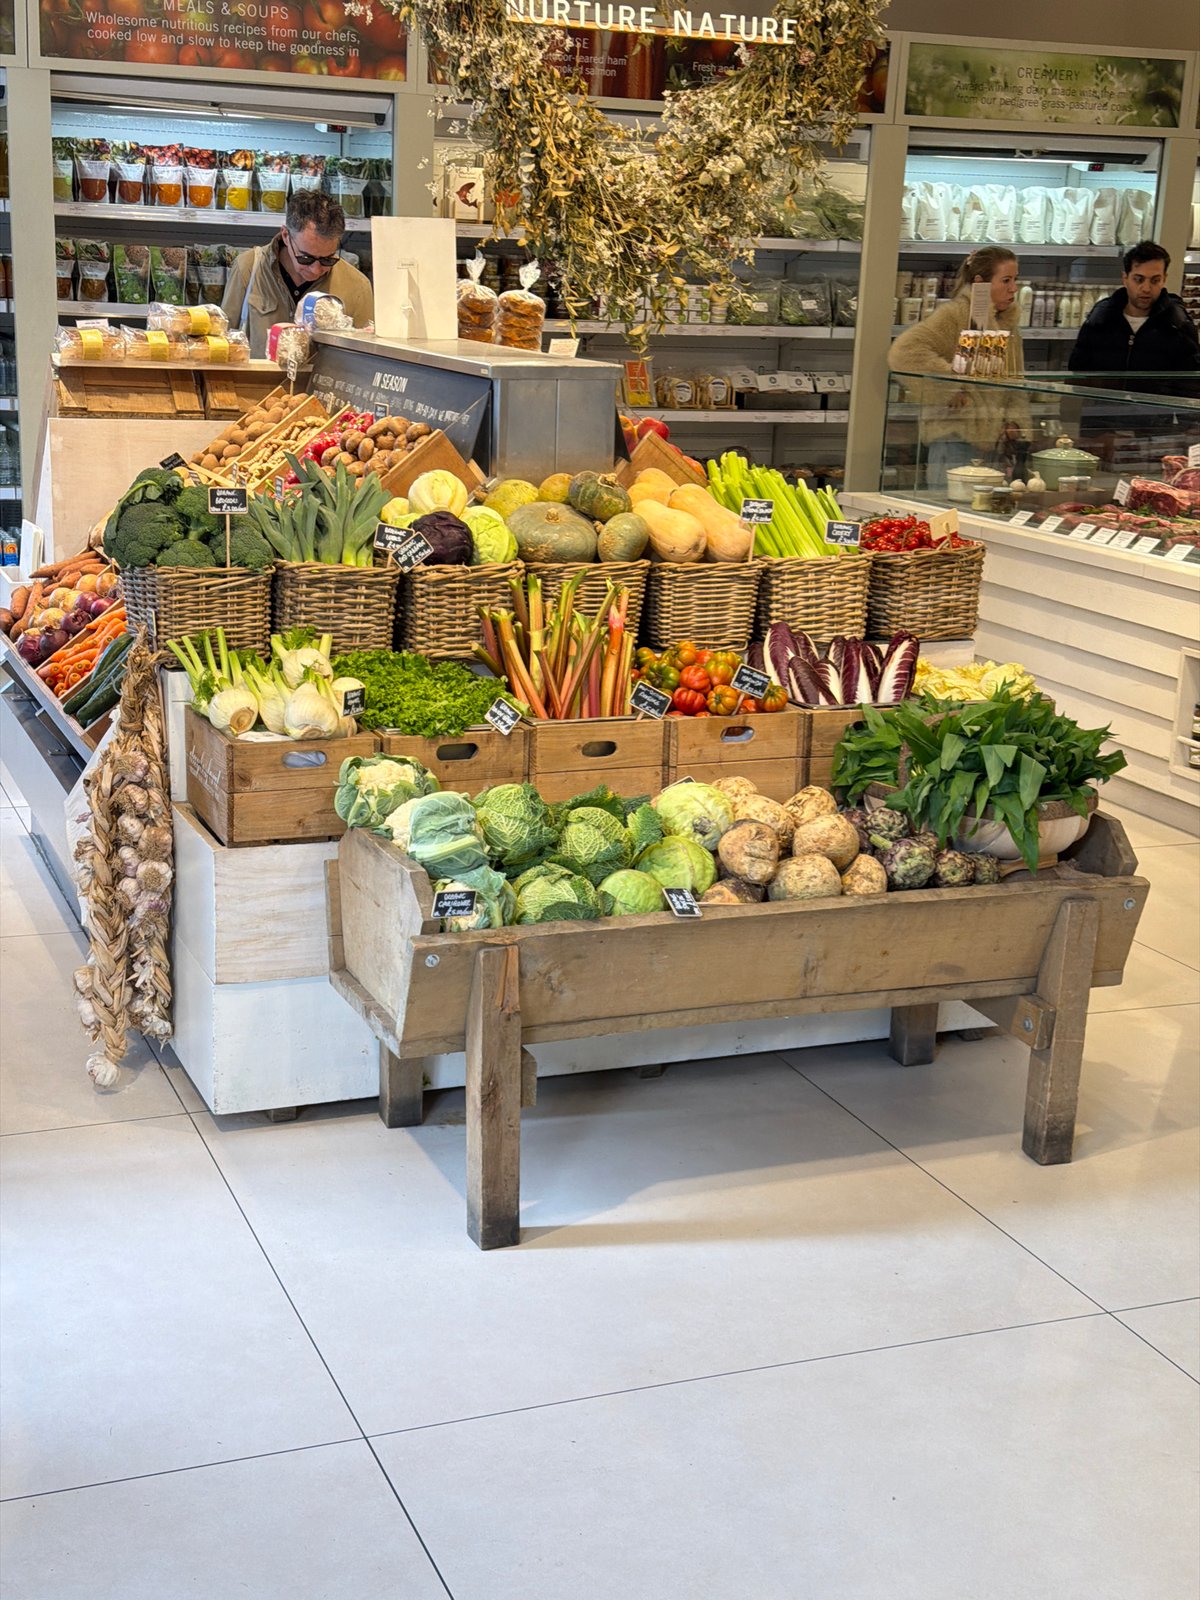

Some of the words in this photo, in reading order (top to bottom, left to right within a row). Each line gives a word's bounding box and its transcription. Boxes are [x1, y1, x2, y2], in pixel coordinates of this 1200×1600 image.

[163, 0, 214, 14] MEALS
[221, 2, 231, 15] &
[237, 3, 289, 19] SOUPS
[86, 11, 158, 28] Wholesome
[162, 19, 220, 32] nutritious
[223, 23, 267, 36] recipes
[271, 25, 298, 38] from
[302, 29, 321, 40] our
[325, 30, 360, 44] chefs,
[505, 0, 656, 33] NURTURE
[674, 10, 798, 44] NATURE
[87, 28, 132, 41] cooked
[136, 30, 157, 42] low
[161, 33, 184, 44] and
[188, 35, 215, 46] slow
[219, 37, 230, 48] to
[234, 37, 263, 52] keep
[267, 40, 286, 51] the
[290, 43, 345, 56] goodness
[348, 46, 360, 57] in
[607, 56, 627, 66] ham
[692, 61, 717, 72] Fresh
[585, 67, 617, 77] salmon
[1017, 66, 1080, 82] CREAMERY
[1051, 87, 1076, 97] made
[981, 97, 997, 105] our
[372, 372, 382, 387] IN
[381, 373, 409, 393] SEASON
